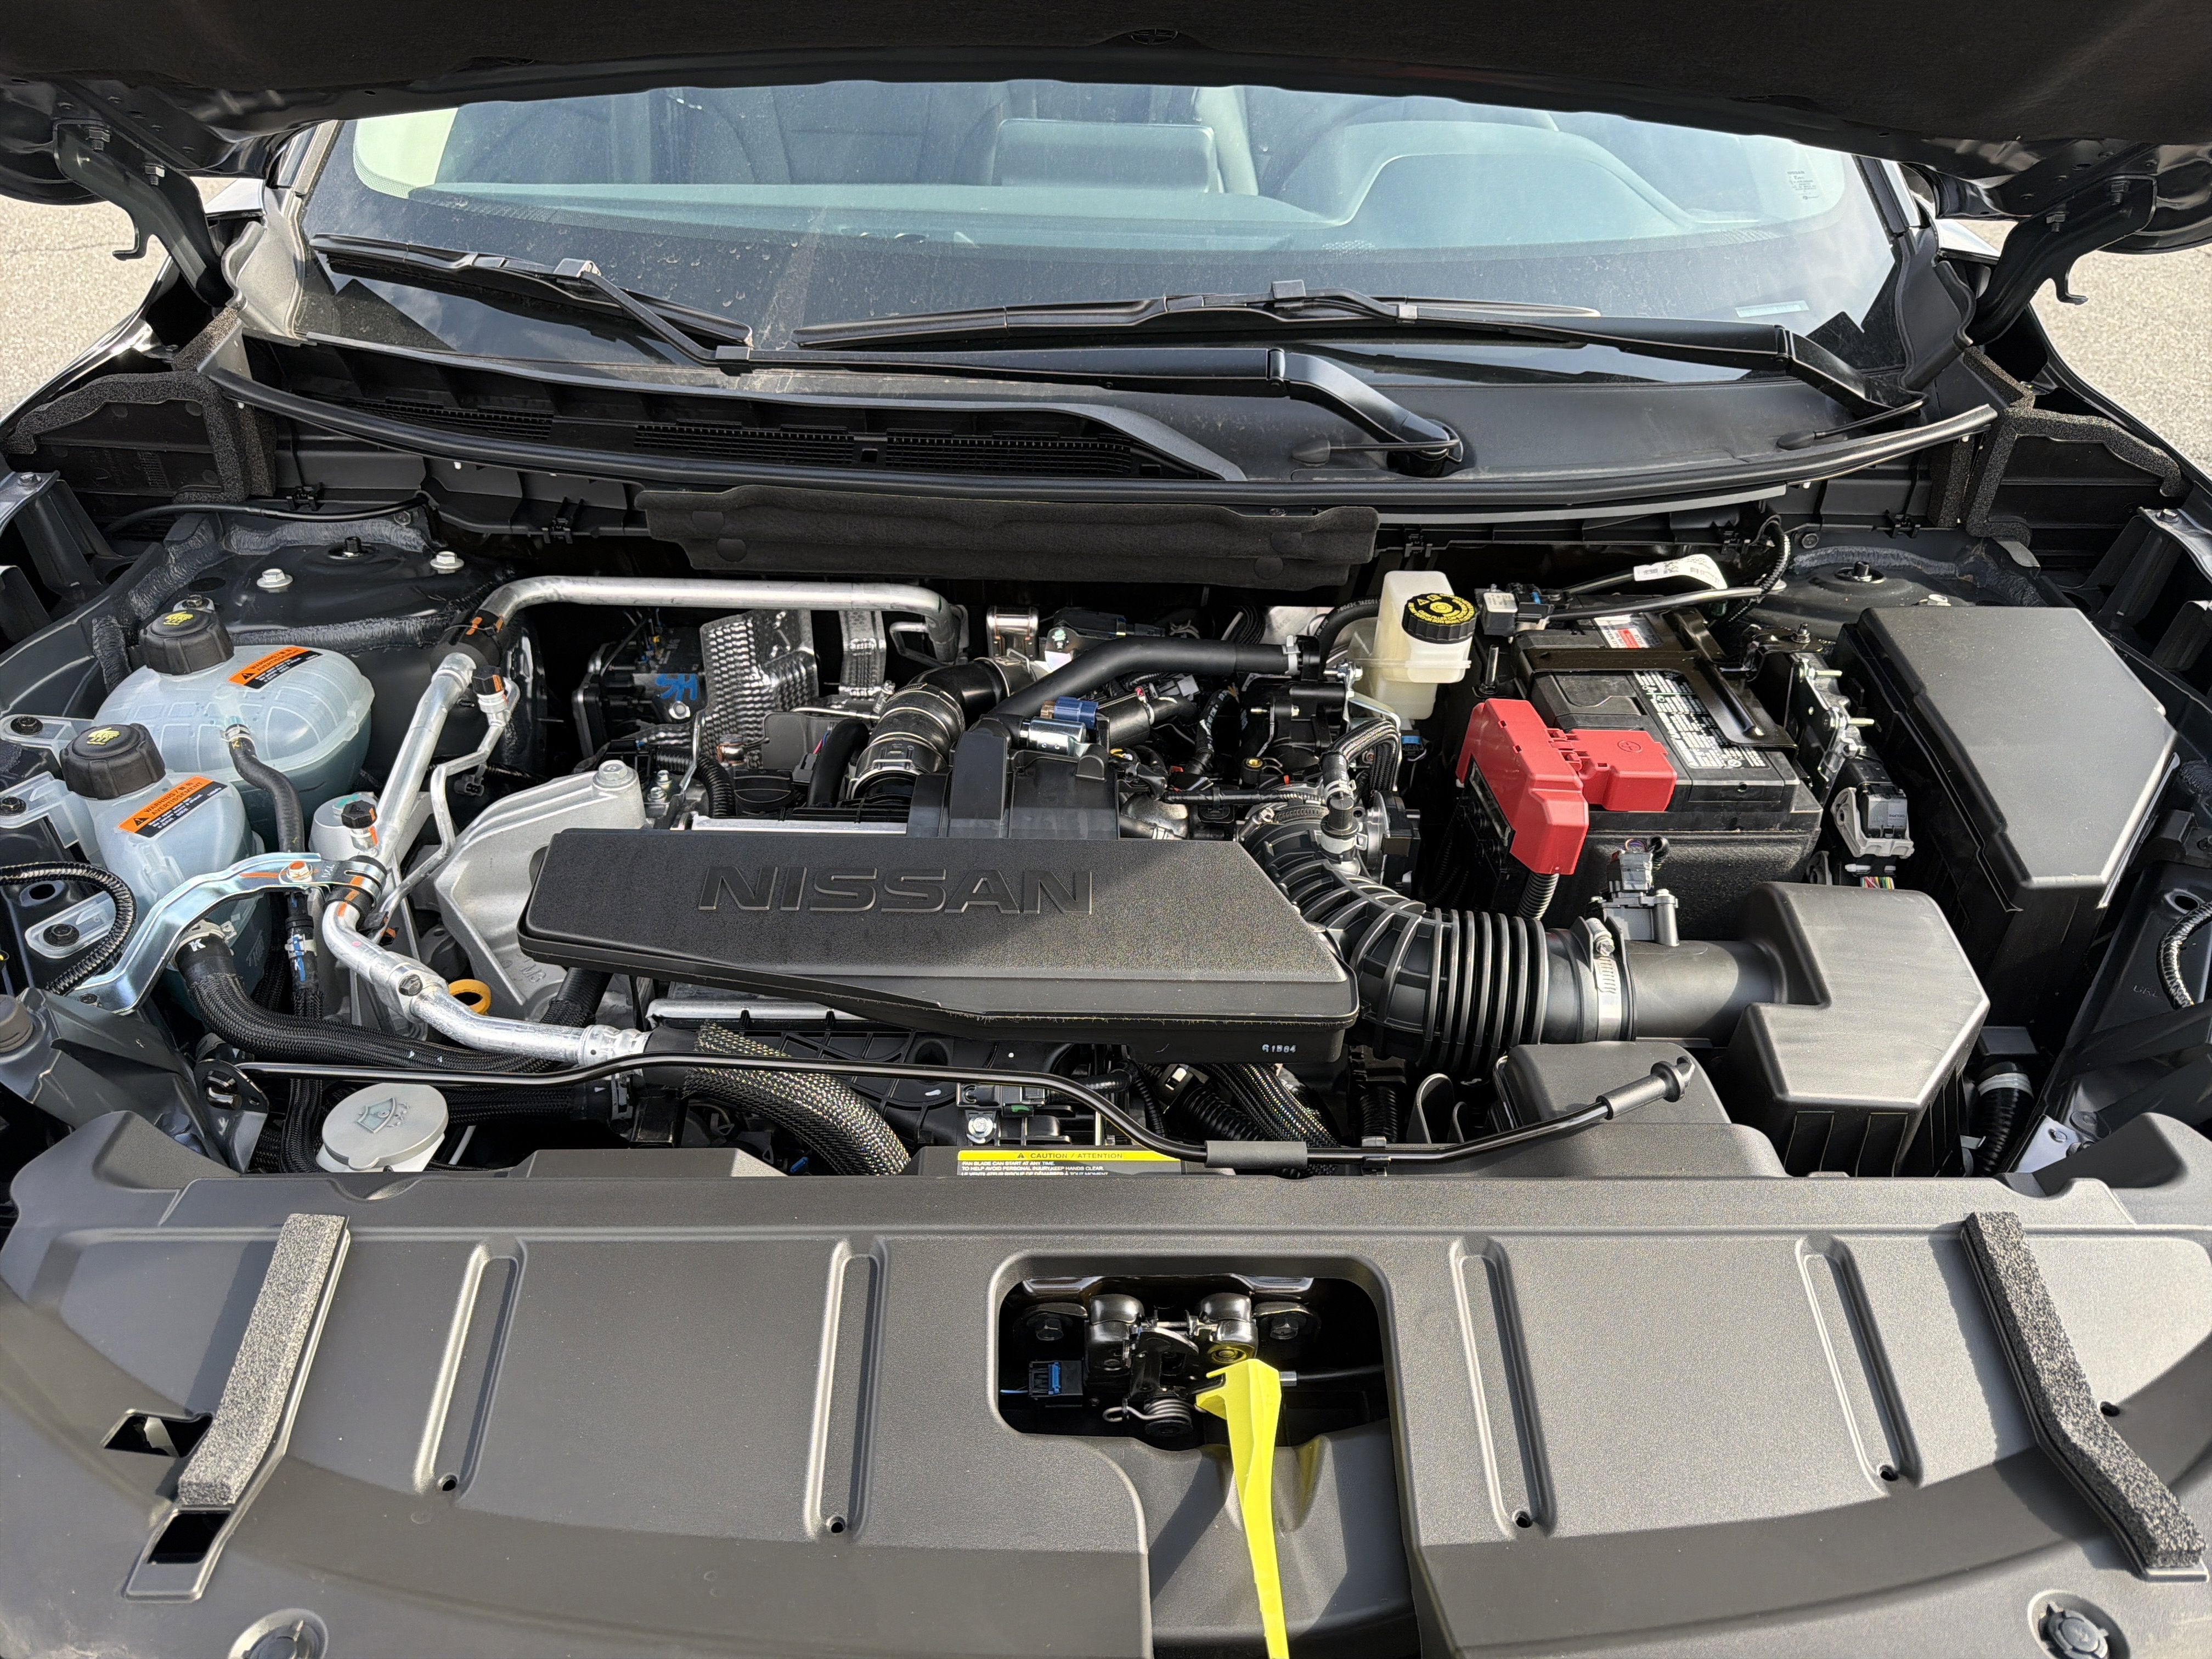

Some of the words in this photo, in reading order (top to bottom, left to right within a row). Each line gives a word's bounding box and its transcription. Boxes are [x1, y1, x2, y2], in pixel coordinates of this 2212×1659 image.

[144, 793, 176, 812] WARNING
[151, 782, 202, 815] AVERTISSEMENT
[698, 867, 1092, 915] NISSAN
[188, 939, 206, 952] K
